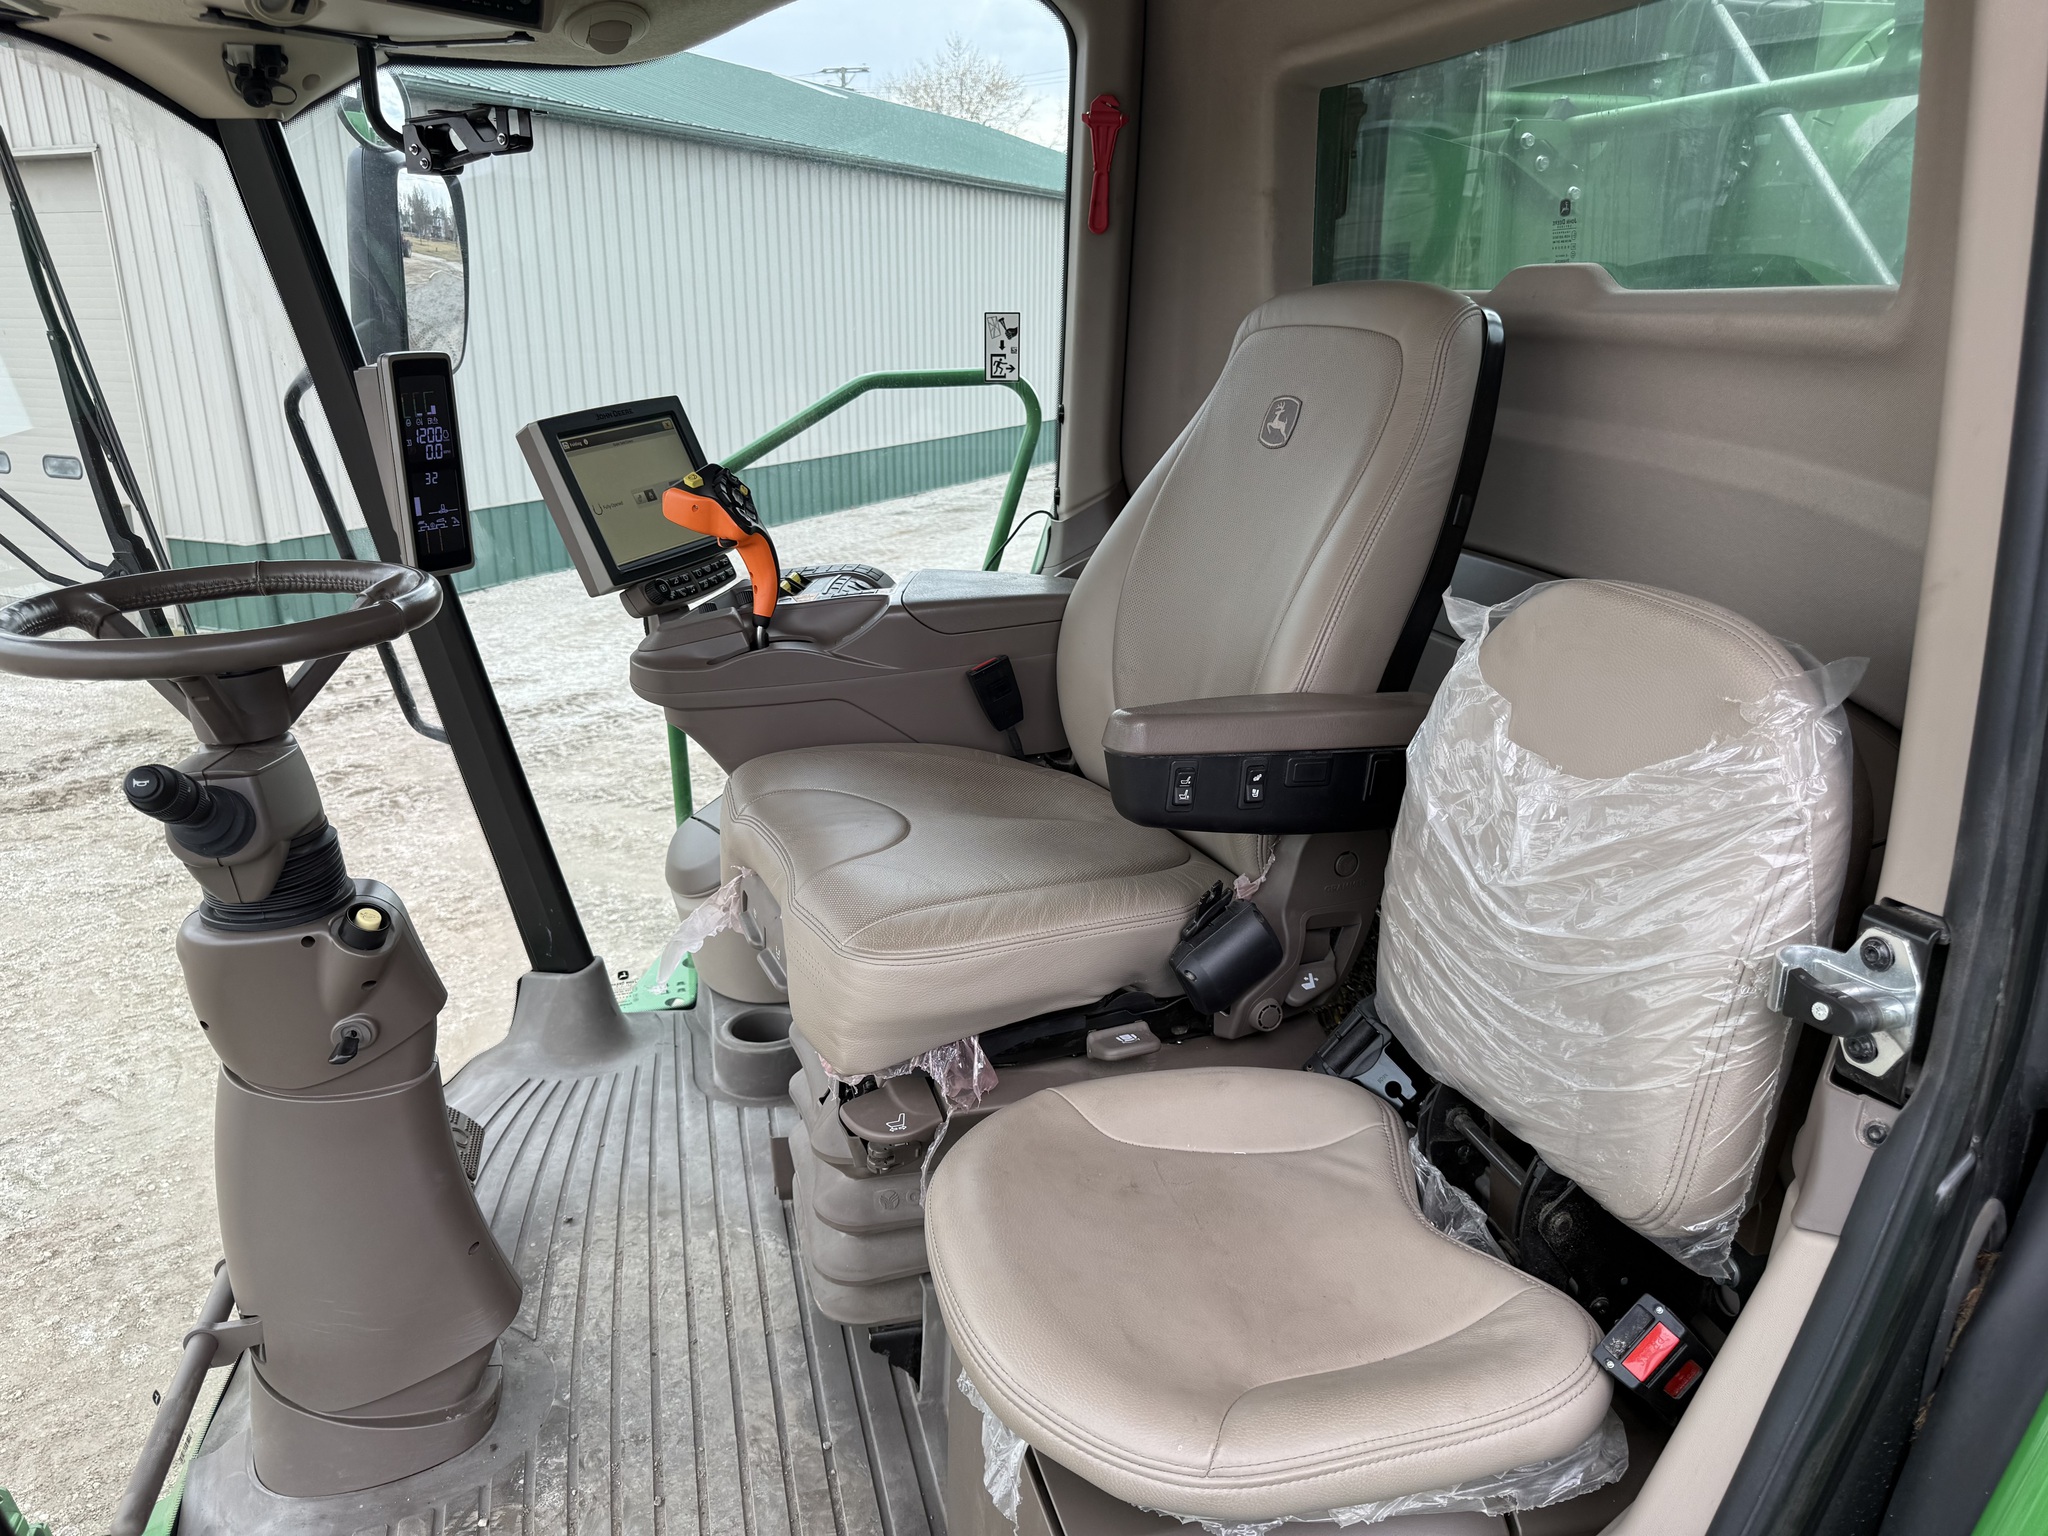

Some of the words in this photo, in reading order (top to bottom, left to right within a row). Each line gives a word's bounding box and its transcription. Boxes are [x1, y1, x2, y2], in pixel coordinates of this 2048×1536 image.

[596, 412, 613, 421] JOHN
[612, 408, 634, 418] DEERE
[416, 426, 443, 444] 1200
[426, 443, 443, 460] 0.0
[425, 471, 438, 485] 32
